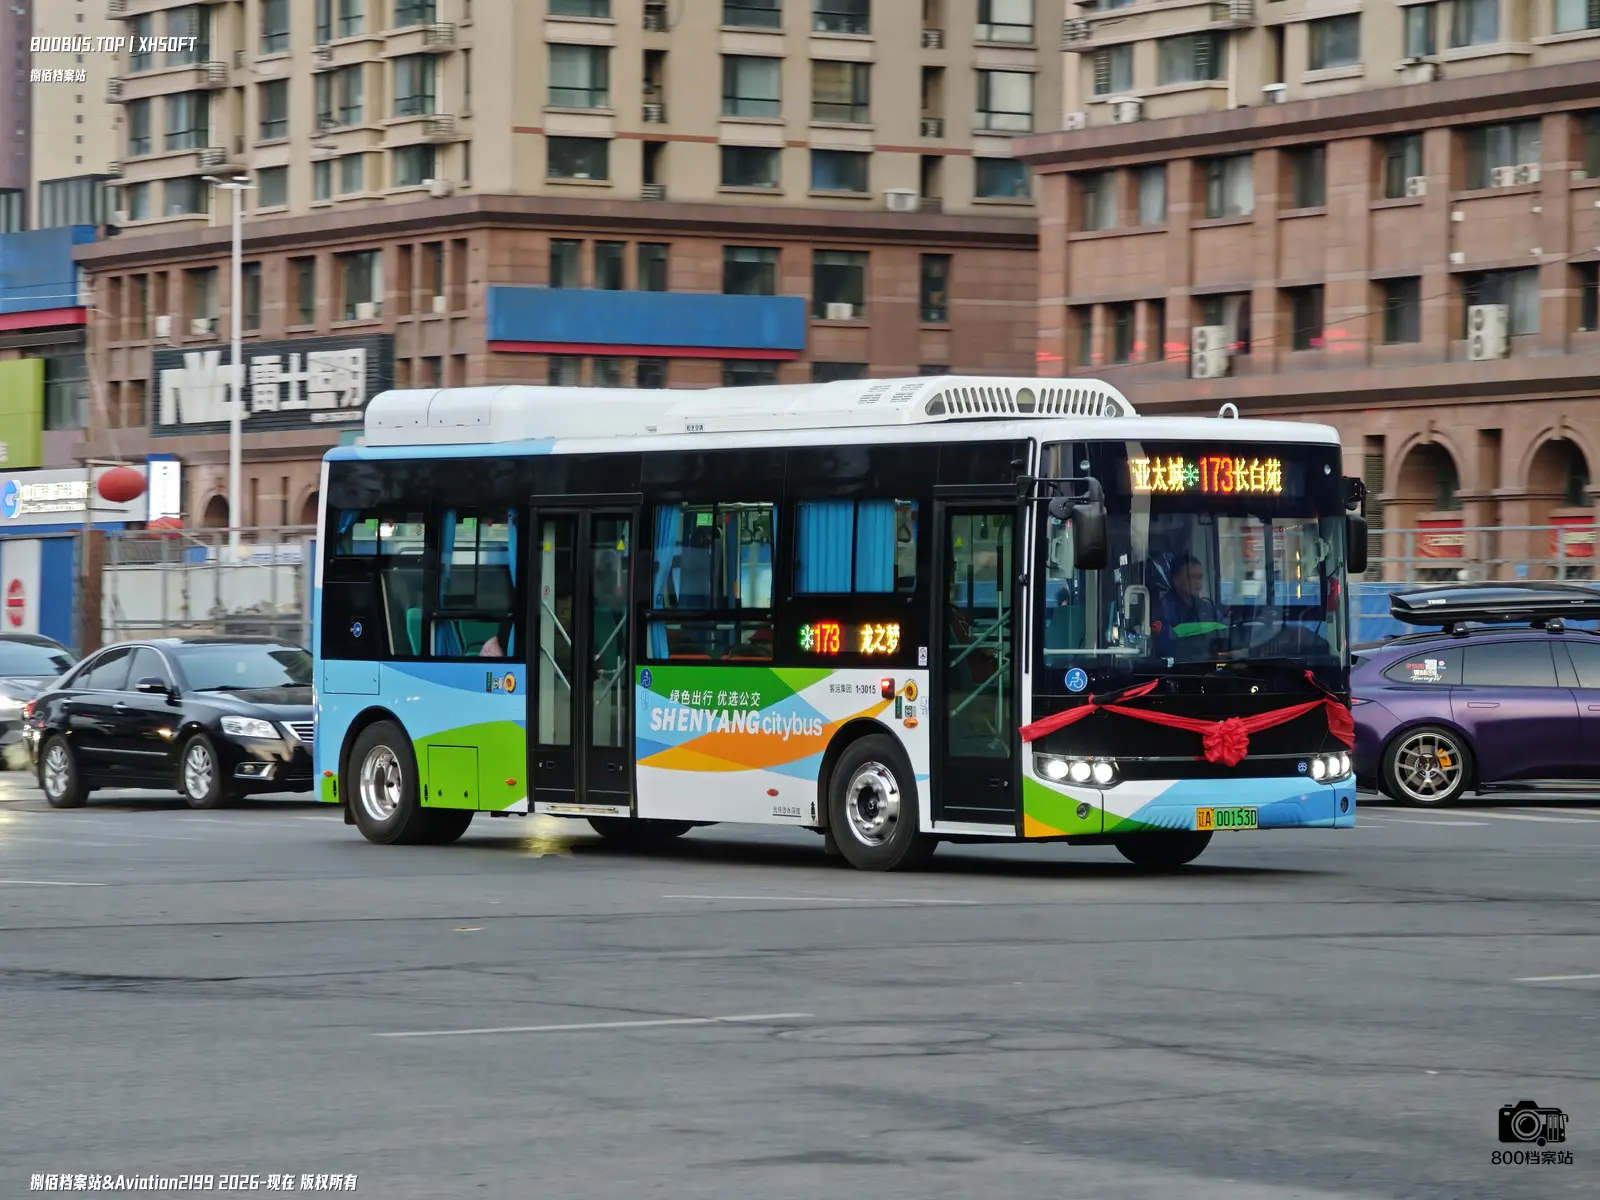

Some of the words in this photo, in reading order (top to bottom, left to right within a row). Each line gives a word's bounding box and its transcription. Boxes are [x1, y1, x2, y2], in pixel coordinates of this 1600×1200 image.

[1131, 457, 1185, 492] 亚太城
[1200, 457, 1233, 492] 173
[1233, 457, 1282, 492] 长白苑
[814, 623, 840, 653] 173
[860, 623, 900, 653] 龙之梦
[669, 689, 713, 706] 绿色出行
[717, 691, 761, 707] 优选公交
[650, 707, 761, 735] SHENYANG
[762, 711, 823, 742] citybus
[1216, 809, 1257, 827] 00153D
